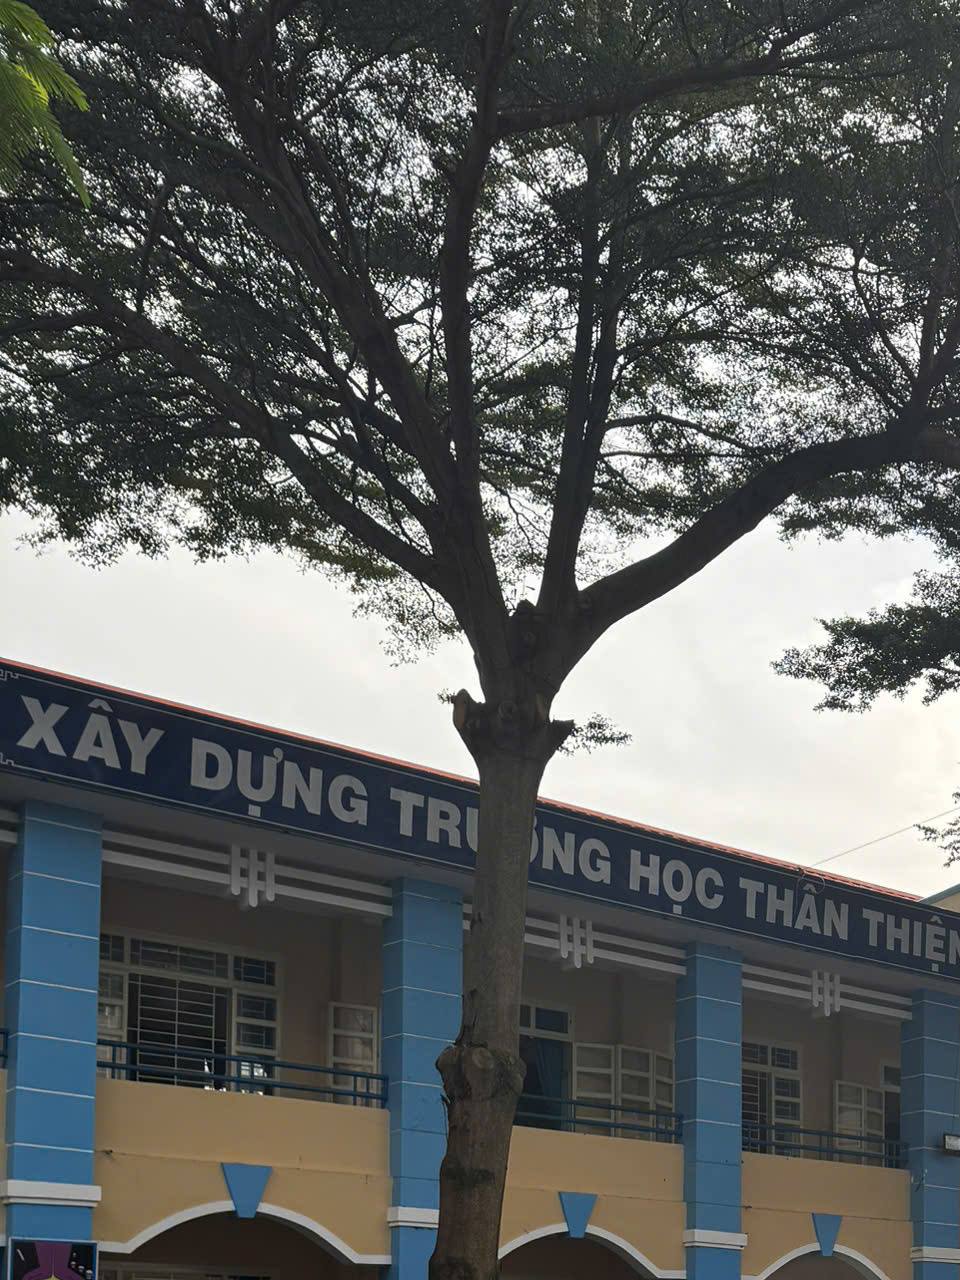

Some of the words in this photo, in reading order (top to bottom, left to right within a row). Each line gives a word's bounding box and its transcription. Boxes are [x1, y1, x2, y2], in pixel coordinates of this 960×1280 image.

[16, 695, 165, 775] XÂY
[190, 737, 369, 826] DỰNG
[390, 787, 611, 885] TRNG
[629, 849, 725, 915] HỌC
[739, 877, 850, 941] THÂN
